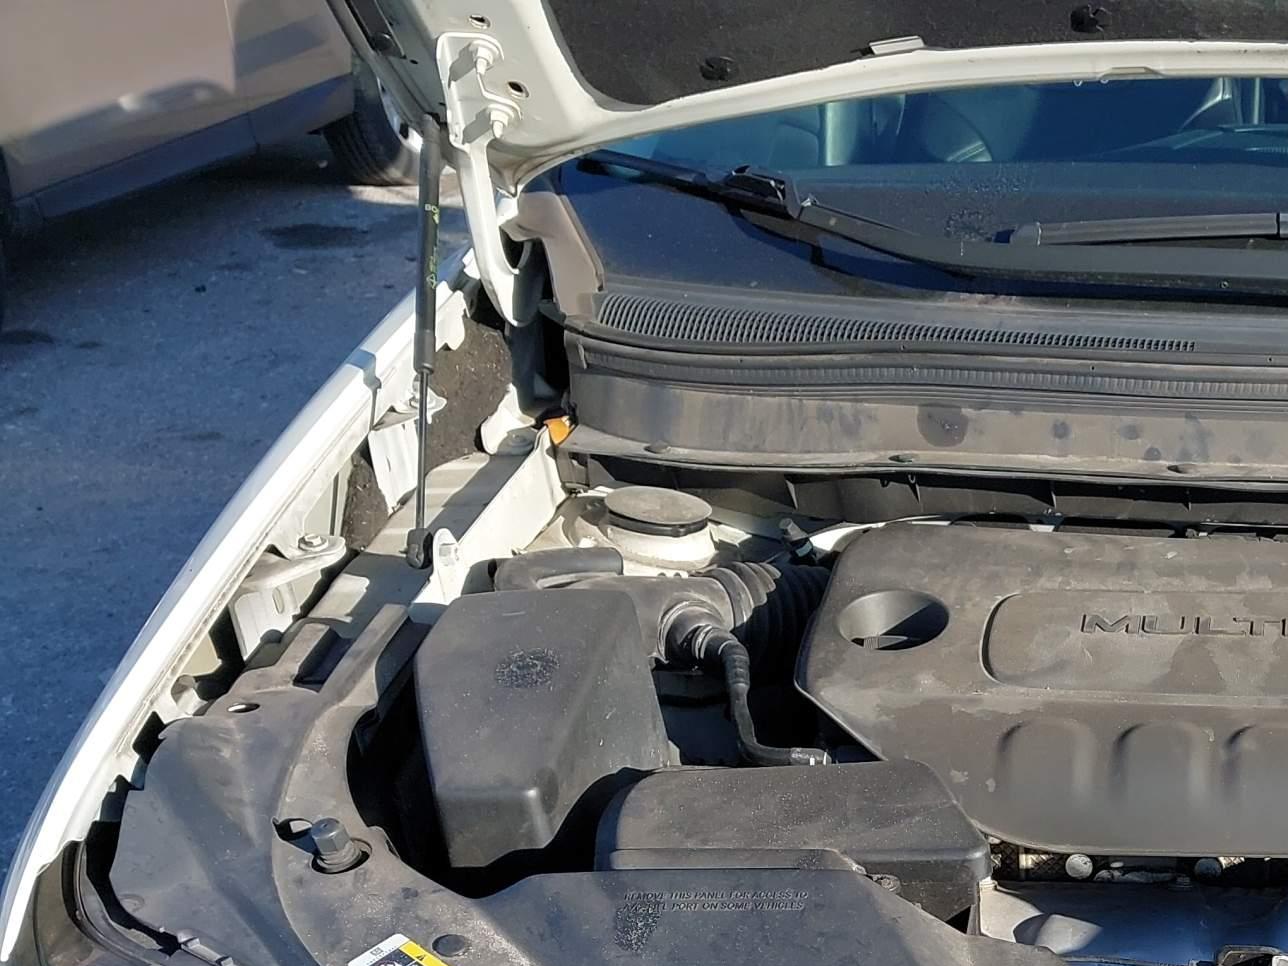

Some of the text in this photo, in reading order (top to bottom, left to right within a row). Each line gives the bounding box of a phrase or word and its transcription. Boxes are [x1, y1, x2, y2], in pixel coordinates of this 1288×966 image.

[624, 891, 664, 901] REMOVE
[670, 891, 691, 900] THIS
[693, 891, 726, 901] PANEL
[729, 891, 751, 900] FOR
[751, 890, 793, 900] ACCESS
[671, 902, 700, 912] PORT
[702, 902, 719, 912] ON
[719, 902, 750, 912] SOME
[752, 902, 805, 912] VEHICLES
